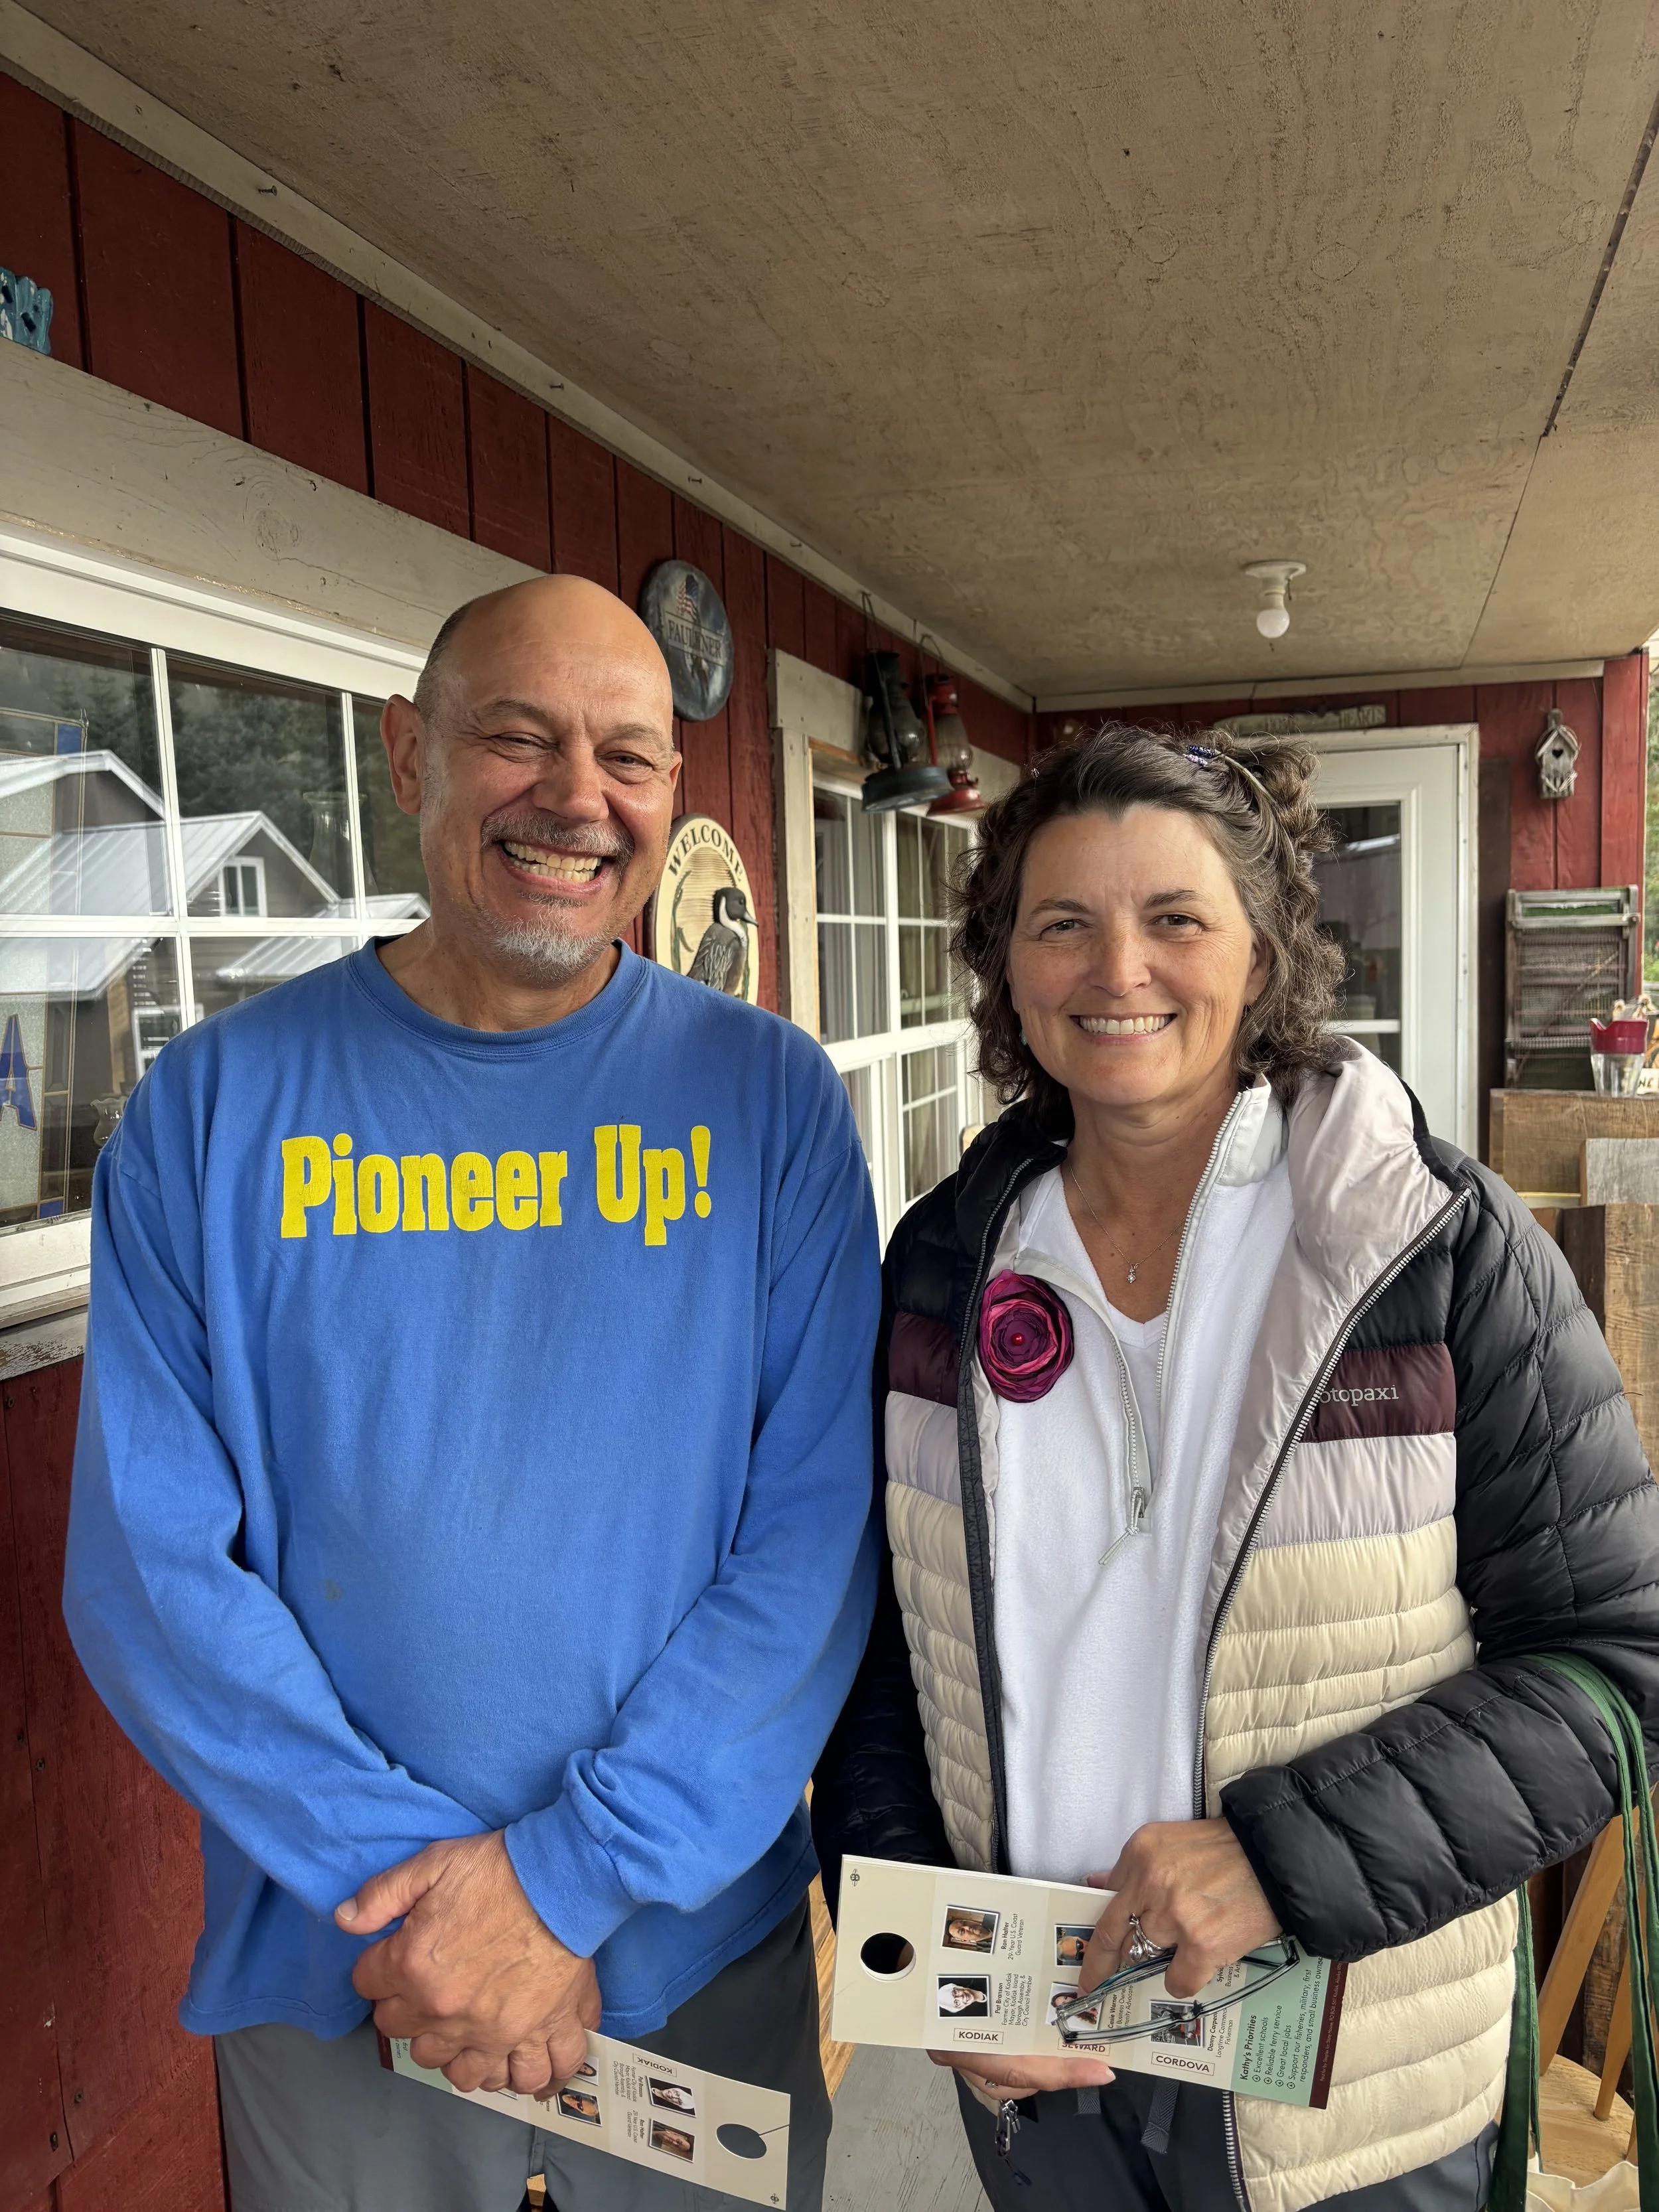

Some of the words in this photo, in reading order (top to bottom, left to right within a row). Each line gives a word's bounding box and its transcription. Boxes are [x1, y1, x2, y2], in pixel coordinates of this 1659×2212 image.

[668, 619, 721, 658] FAULNER
[668, 825, 743, 882] WELCOME
[281, 1132, 567, 1238] Pioneer
[594, 1124, 711, 1246] Up!
[1319, 1384, 1399, 1406] otopaxi
[1273, 2005, 1282, 2029] service
[958, 2031, 999, 2041] KODIAK
[1207, 2034, 1216, 2051] Danny
[1244, 2015, 1257, 2050] Priorities
[1269, 2031, 1280, 2047] ferry
[1283, 2025, 1292, 2039] jobs
[1300, 2044, 1312, 2082] responders,
[1311, 1980, 1320, 2009] business
[1254, 2043, 1264, 2073] Excellent
[1280, 2040, 1289, 2057] local
[1289, 2055, 1299, 2080] Support
[1294, 2012, 1307, 2039] fisheries,
[637, 2057, 672, 2074] KODIAK
[1155, 2055, 1210, 2072] CORDOVA
[1240, 2052, 1252, 2080] Kathy's
[1265, 2049, 1275, 2075] Reliable
[1277, 2058, 1286, 2077] Great
